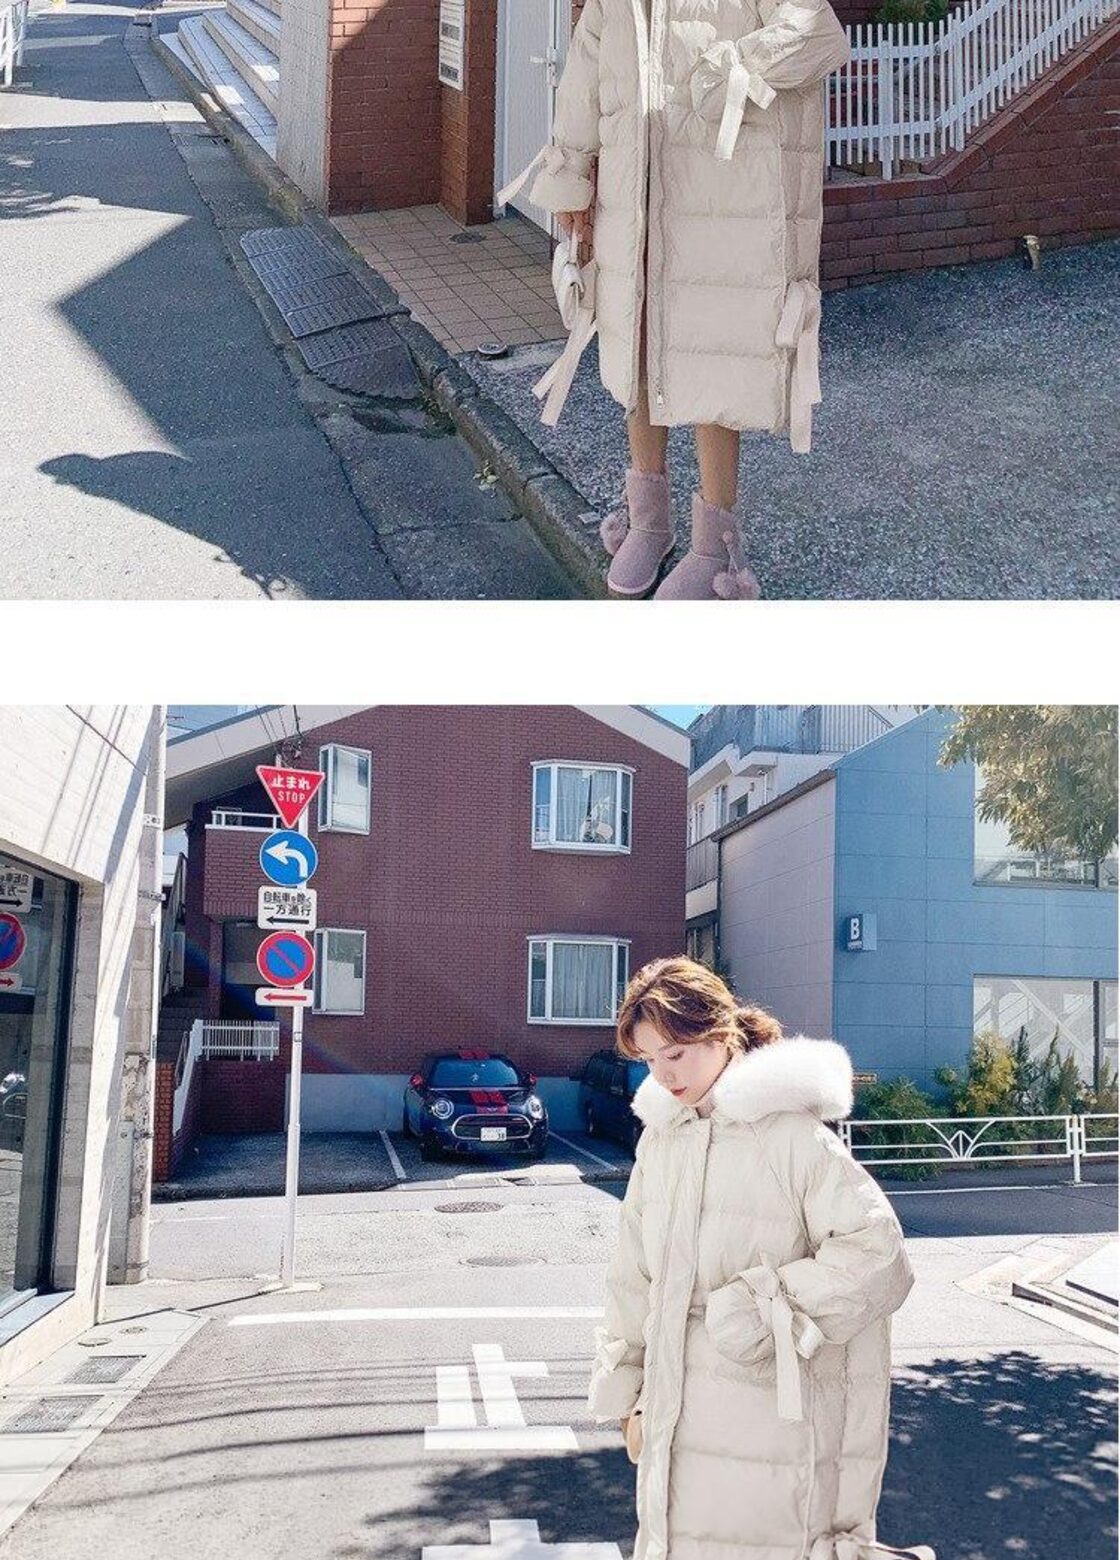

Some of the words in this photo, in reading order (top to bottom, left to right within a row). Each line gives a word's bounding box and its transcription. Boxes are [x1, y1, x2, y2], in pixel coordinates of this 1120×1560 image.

[271, 774, 311, 790] 止まれ
[278, 790, 305, 803] STOP
[263, 903, 311, 916] 一方通行
[850, 917, 860, 940] B
